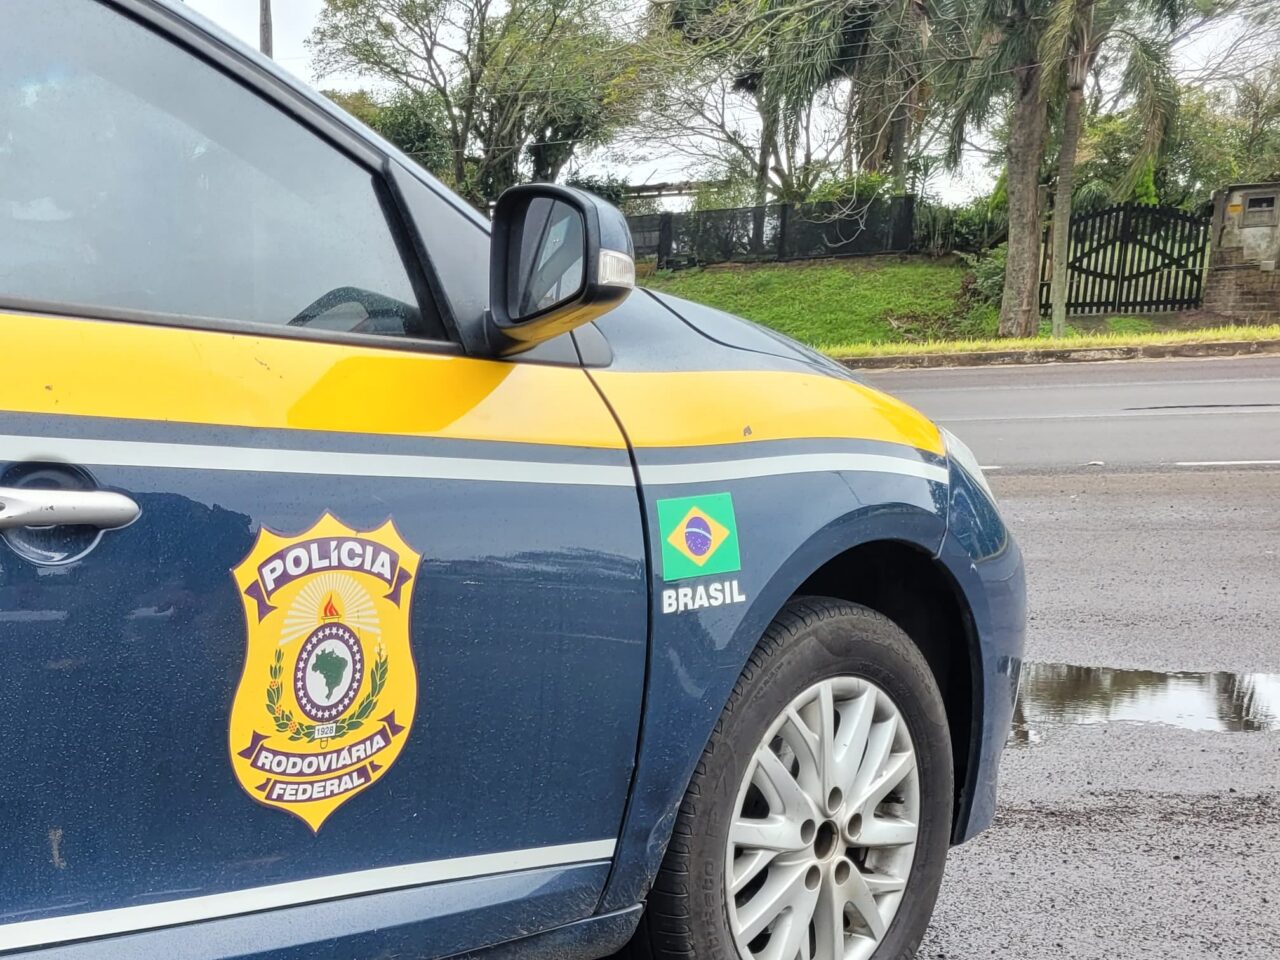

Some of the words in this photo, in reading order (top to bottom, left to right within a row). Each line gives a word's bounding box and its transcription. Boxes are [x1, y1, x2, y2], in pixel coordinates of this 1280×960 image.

[261, 540, 392, 591] POLÍCIA
[662, 580, 746, 614] BRASIL
[316, 726, 334, 737] 1928
[257, 734, 387, 774] RODOVIÁRIA
[271, 772, 366, 801] FEDERAL
